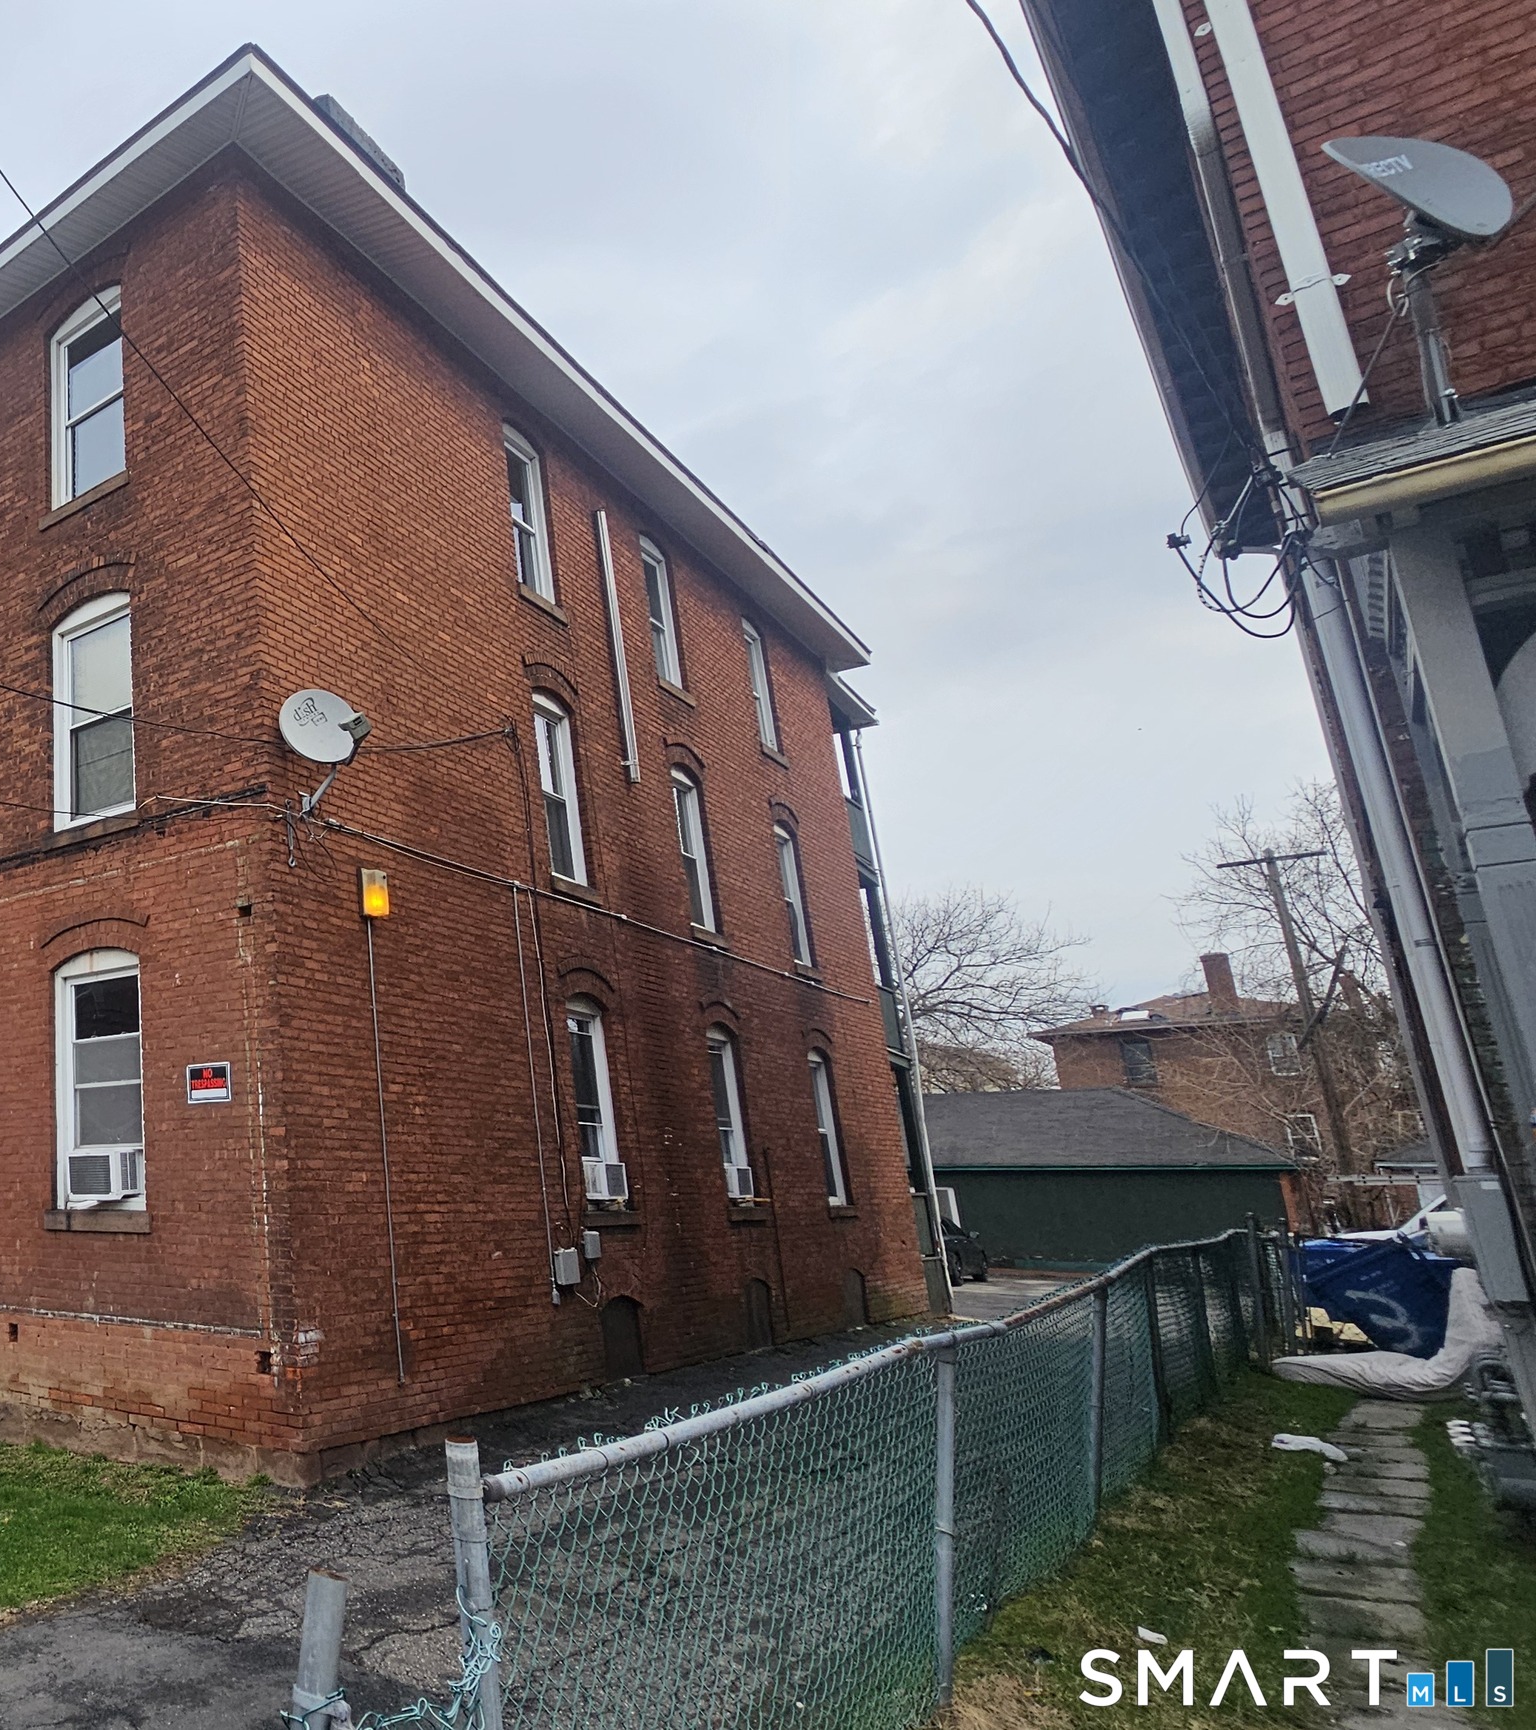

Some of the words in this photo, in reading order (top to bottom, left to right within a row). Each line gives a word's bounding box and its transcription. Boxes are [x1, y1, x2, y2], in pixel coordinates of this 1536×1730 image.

[293, 702, 317, 722] dish
[202, 1068, 213, 1079] NO
[191, 1078, 226, 1090] TRESPASSING
